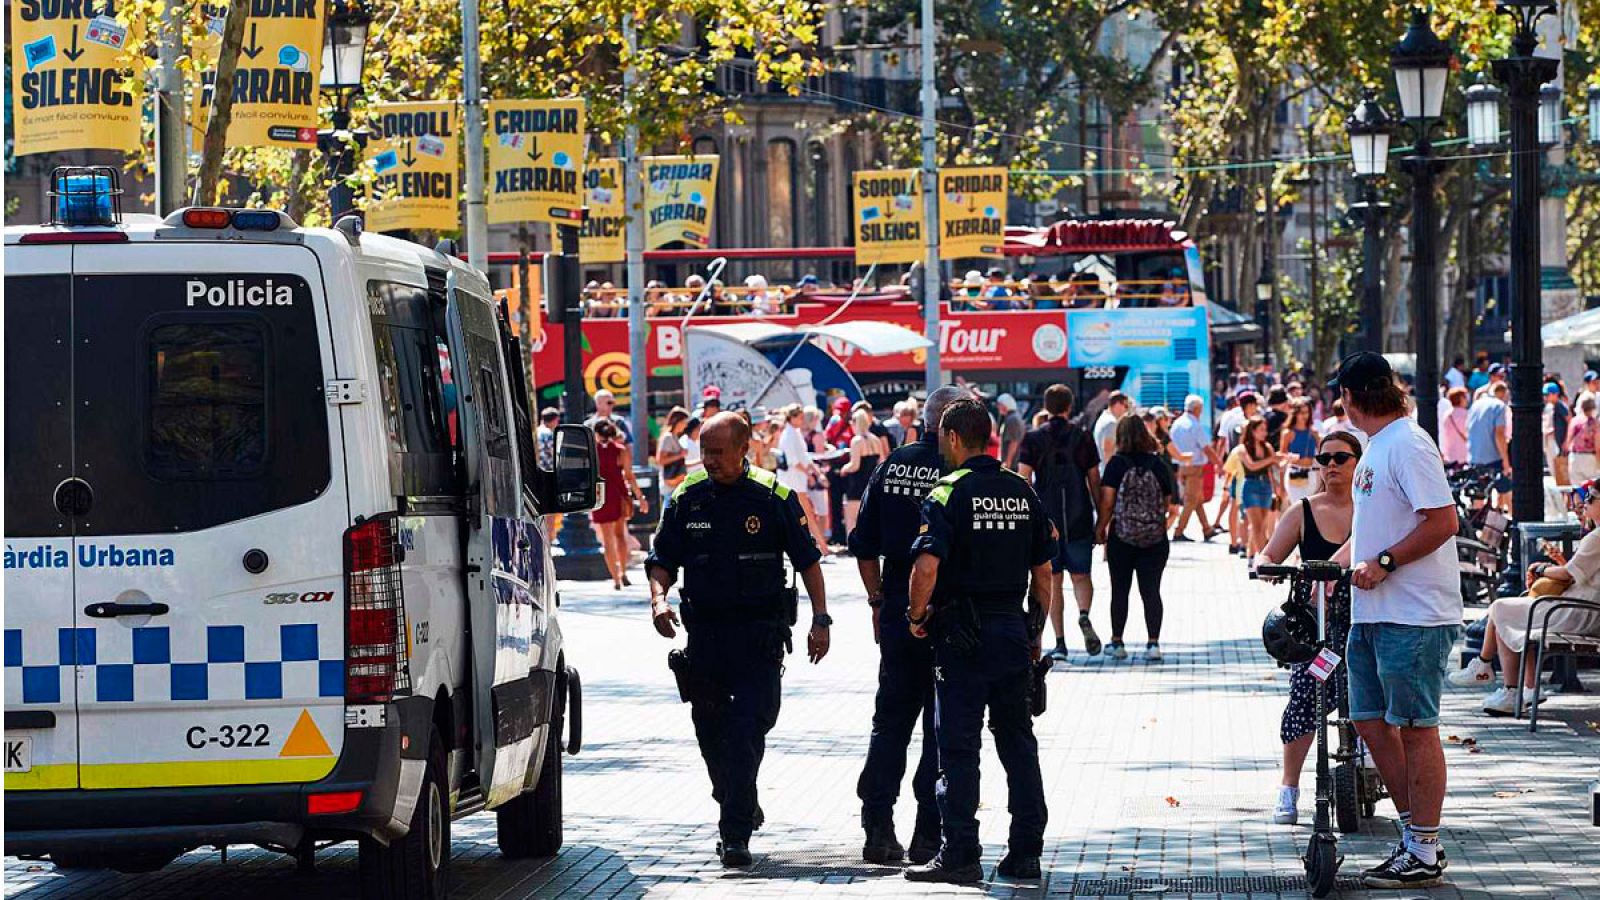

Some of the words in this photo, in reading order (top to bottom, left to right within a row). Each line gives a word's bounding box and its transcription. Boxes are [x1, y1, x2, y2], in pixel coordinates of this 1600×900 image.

[368, 111, 452, 140] SOROLL
[495, 108, 578, 135] CRIDAR
[495, 168, 577, 194] XERRAR
[648, 163, 713, 182] CRIDAR
[944, 174, 1003, 194] CRIDAR
[650, 203, 707, 228] XERRAR
[860, 221, 921, 242] SILENCI
[945, 218, 1002, 238] XERRAR
[186, 279, 293, 306] Policia
[939, 319, 1007, 354] Tour
[887, 463, 940, 481] POLICIA
[972, 496, 1030, 512] POLICIA
[973, 511, 1004, 520] guàrdia
[78, 544, 174, 567] Urbana
[300, 591, 335, 602] CDI
[186, 724, 270, 749] C-322
